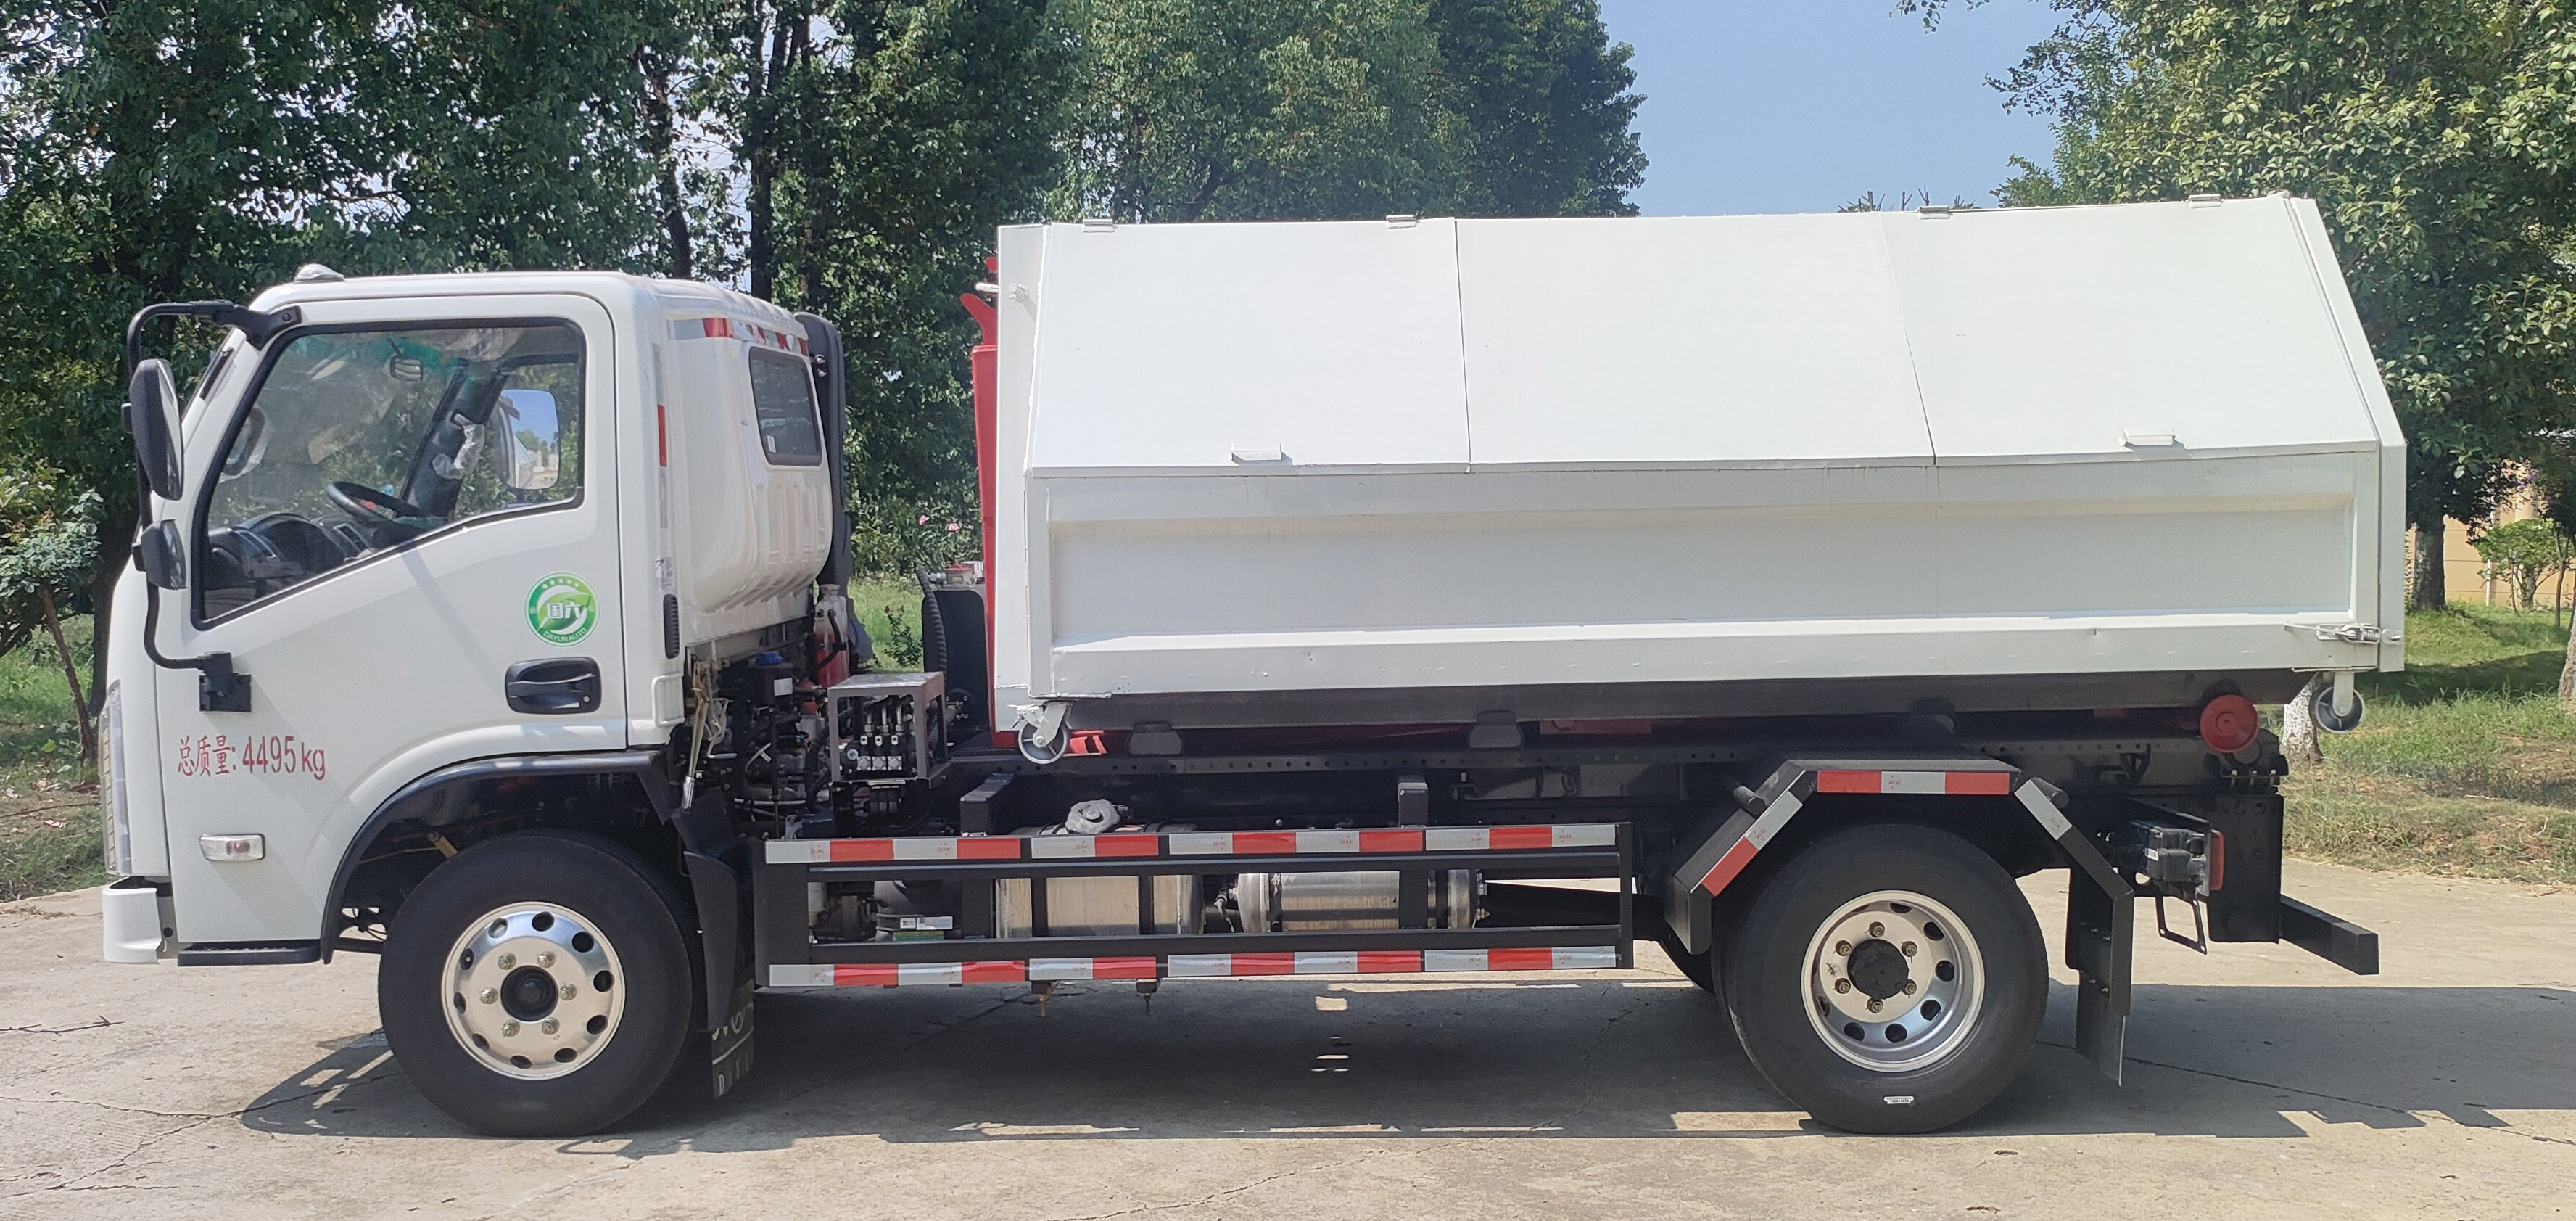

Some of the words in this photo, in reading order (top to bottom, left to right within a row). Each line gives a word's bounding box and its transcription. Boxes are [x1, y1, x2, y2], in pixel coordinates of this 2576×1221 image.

[547, 601, 582, 620] 国六
[543, 630, 568, 642] DAYUN
[569, 627, 587, 640] AUTO
